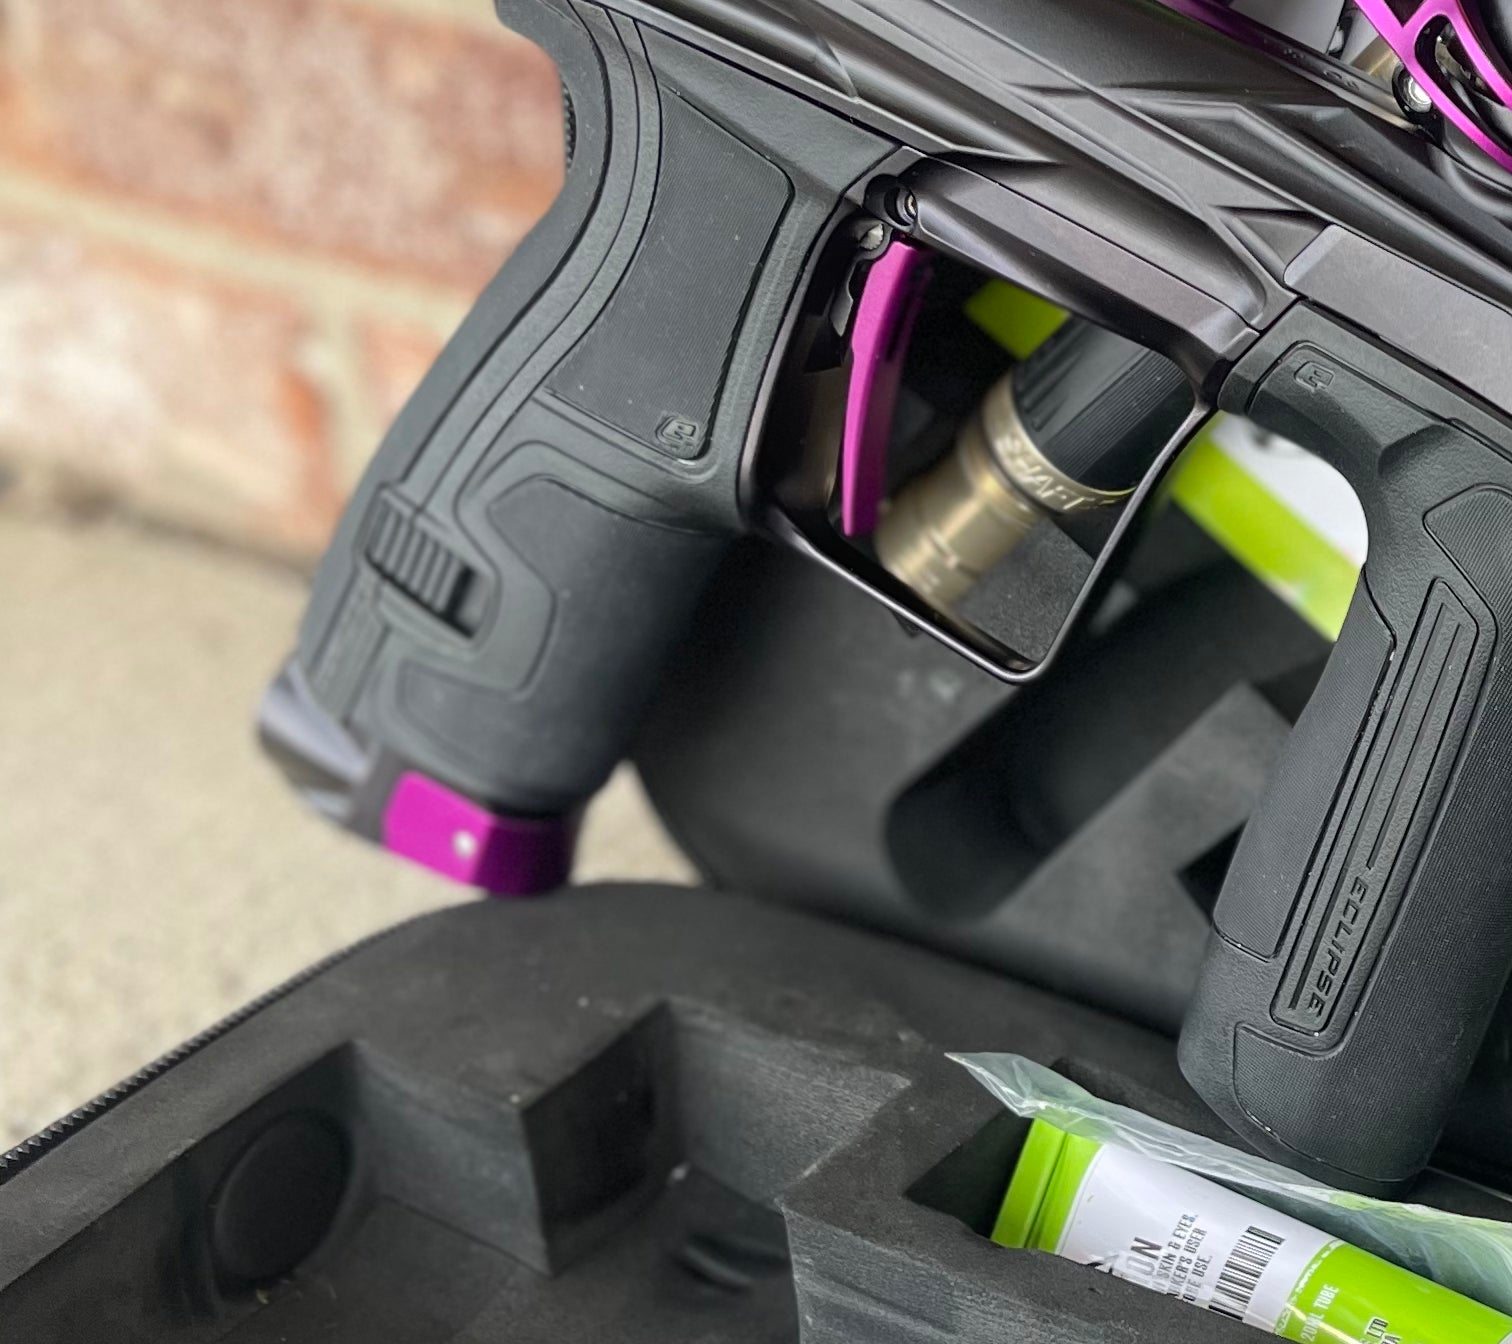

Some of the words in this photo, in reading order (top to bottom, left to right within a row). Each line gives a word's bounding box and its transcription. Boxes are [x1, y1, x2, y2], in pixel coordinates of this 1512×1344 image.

[1307, 876, 1366, 1018] ECLIPSE
[1183, 1228, 1207, 1254] USER
[1156, 1253, 1176, 1279] SKIN
[1301, 1312, 1325, 1342] 20ML
[1313, 1284, 1339, 1310] TUBE
[1367, 1318, 1388, 1338] LTD
